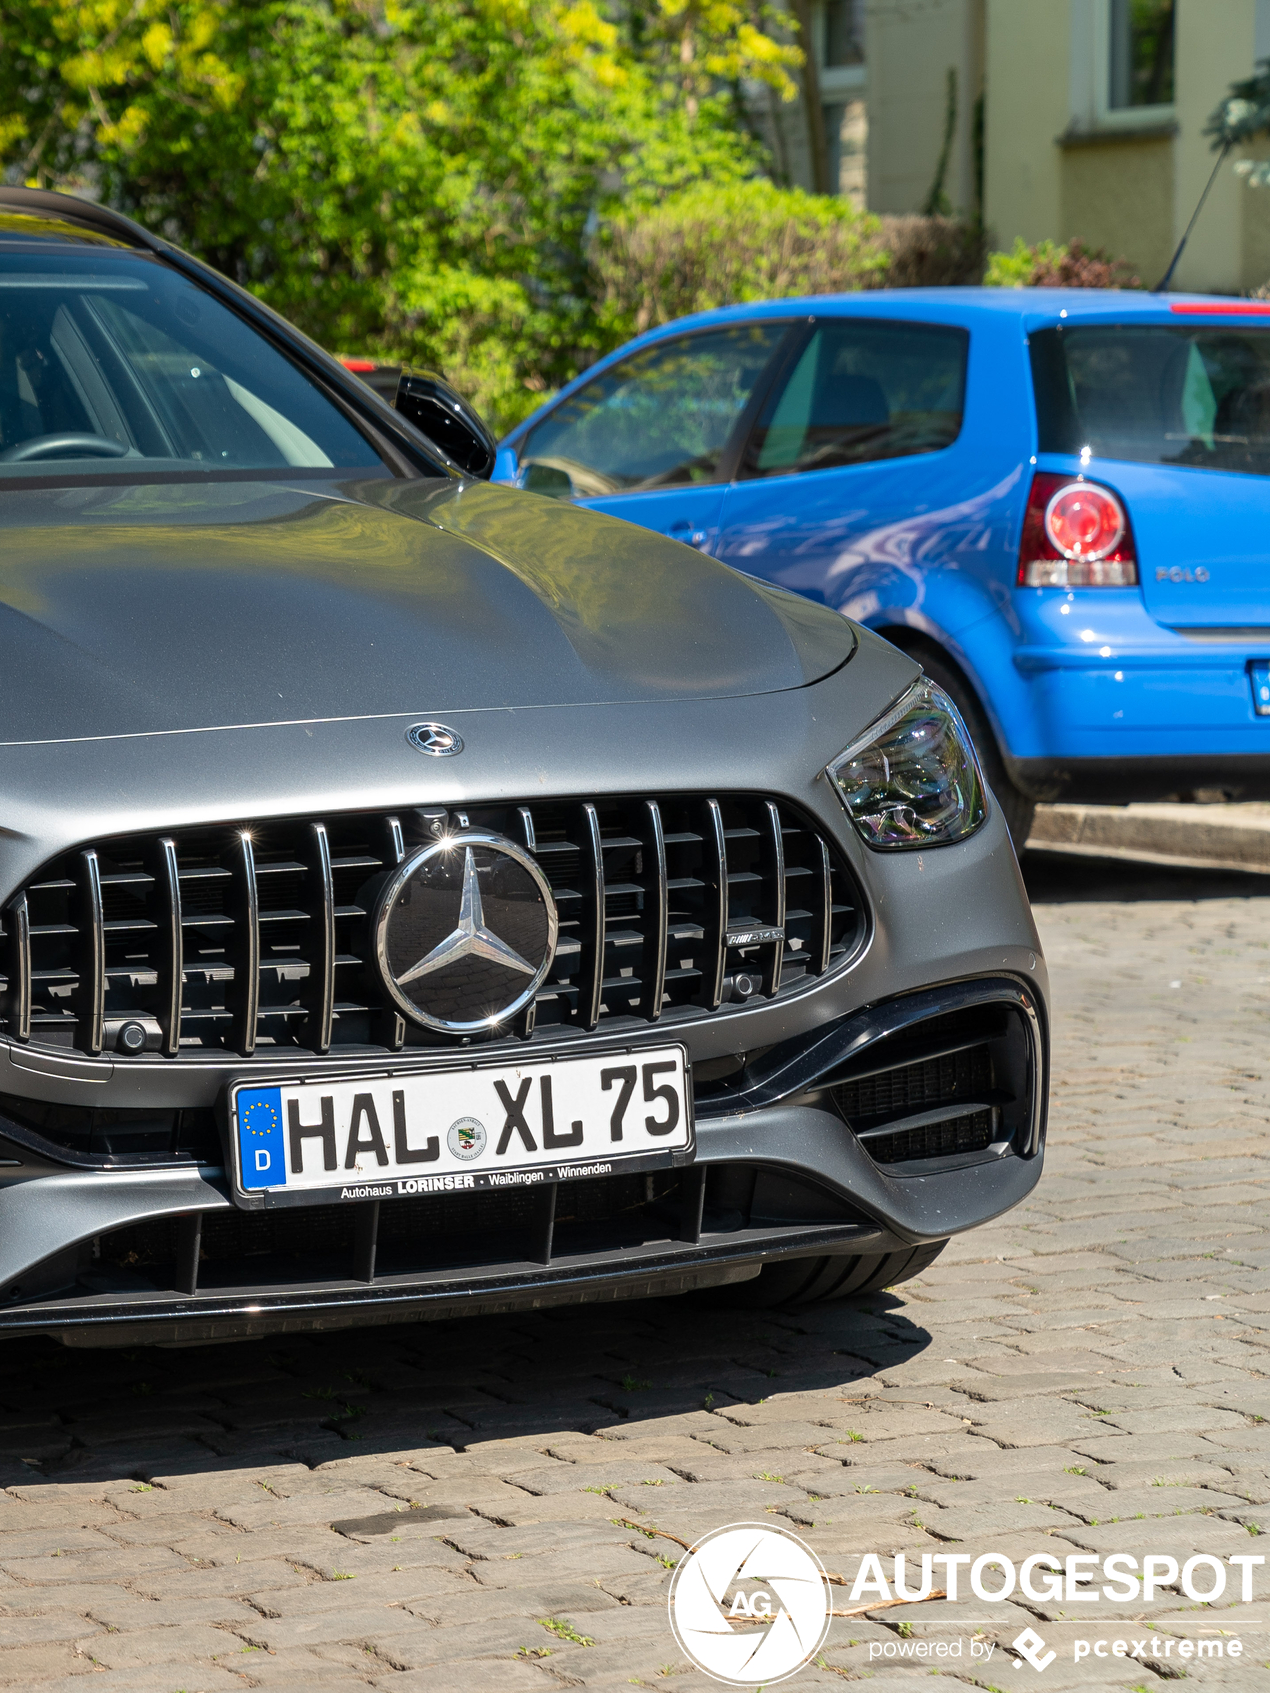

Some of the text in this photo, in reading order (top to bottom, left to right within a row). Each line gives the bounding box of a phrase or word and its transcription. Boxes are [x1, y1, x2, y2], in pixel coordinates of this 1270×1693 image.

[1155, 565, 1210, 583] POLO
[288, 1060, 680, 1174] HAL XL 75
[255, 1149, 271, 1171] D
[341, 1162, 611, 1200] Autohaus LORINSER Waiblingen Winnenden
